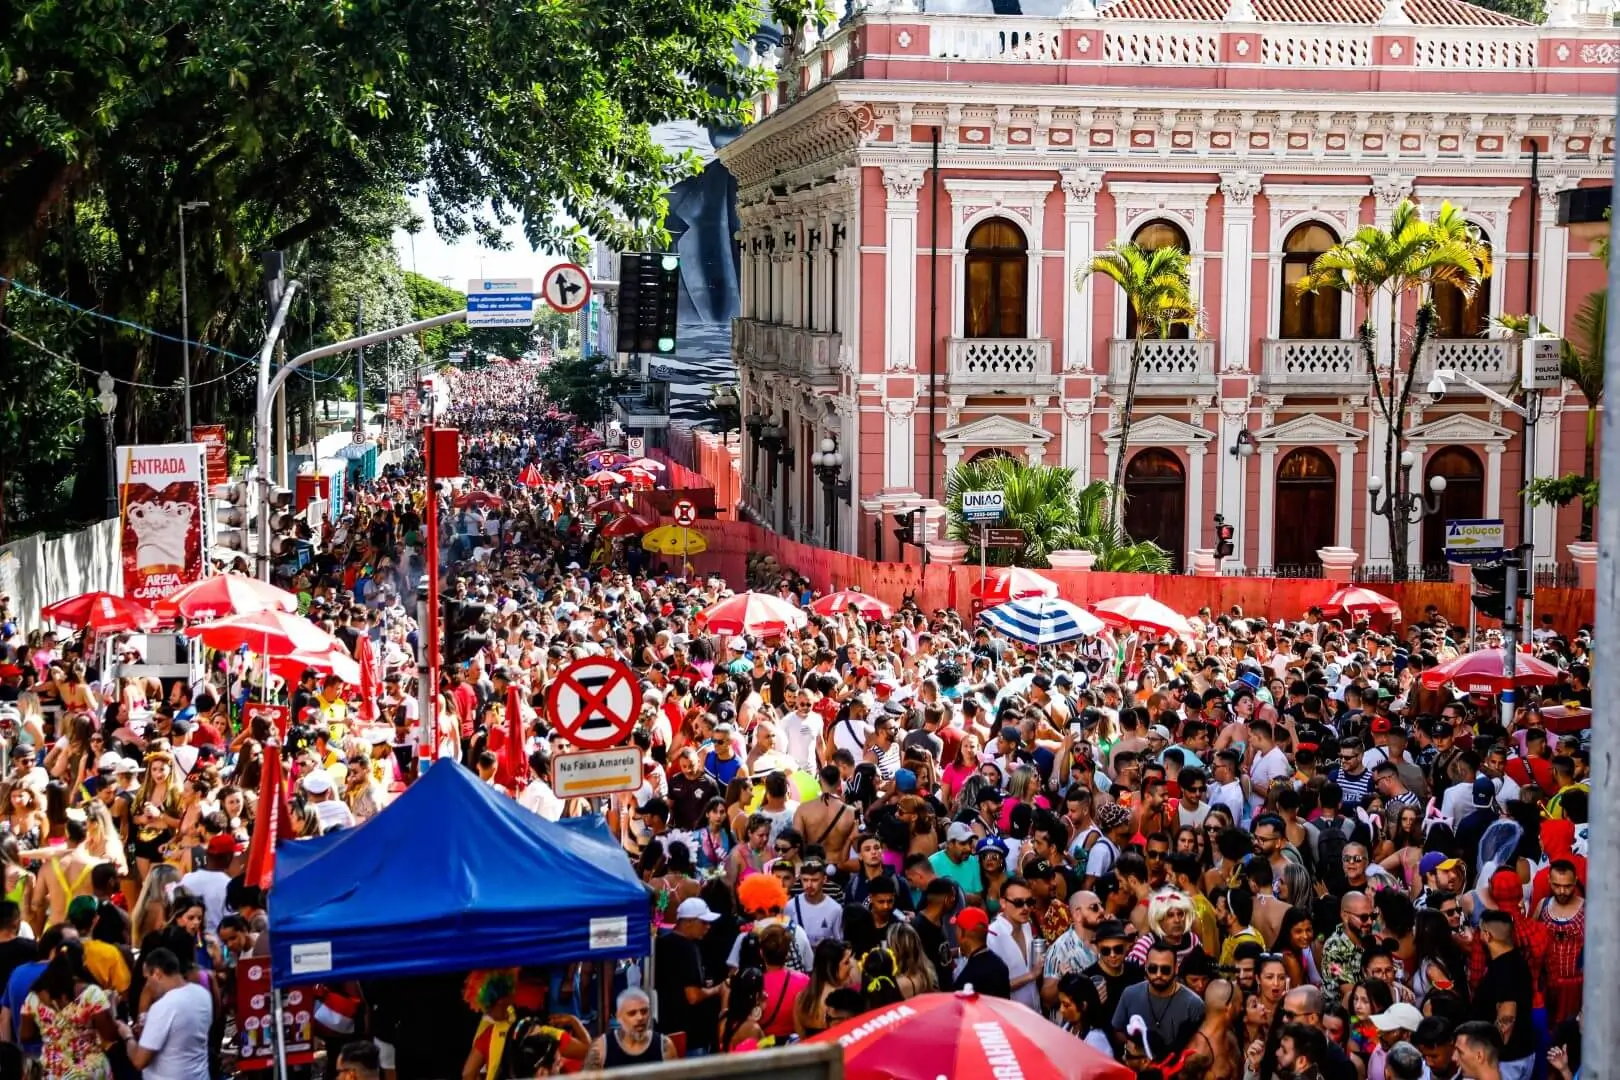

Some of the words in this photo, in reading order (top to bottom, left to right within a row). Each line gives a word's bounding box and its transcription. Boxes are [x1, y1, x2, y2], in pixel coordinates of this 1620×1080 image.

[130, 458, 186, 475] ENTRADA
[560, 762, 572, 772] Na
[573, 760, 597, 771] Faixa
[599, 756, 634, 769] Amarela
[837, 1005, 917, 1048] RAHMA
